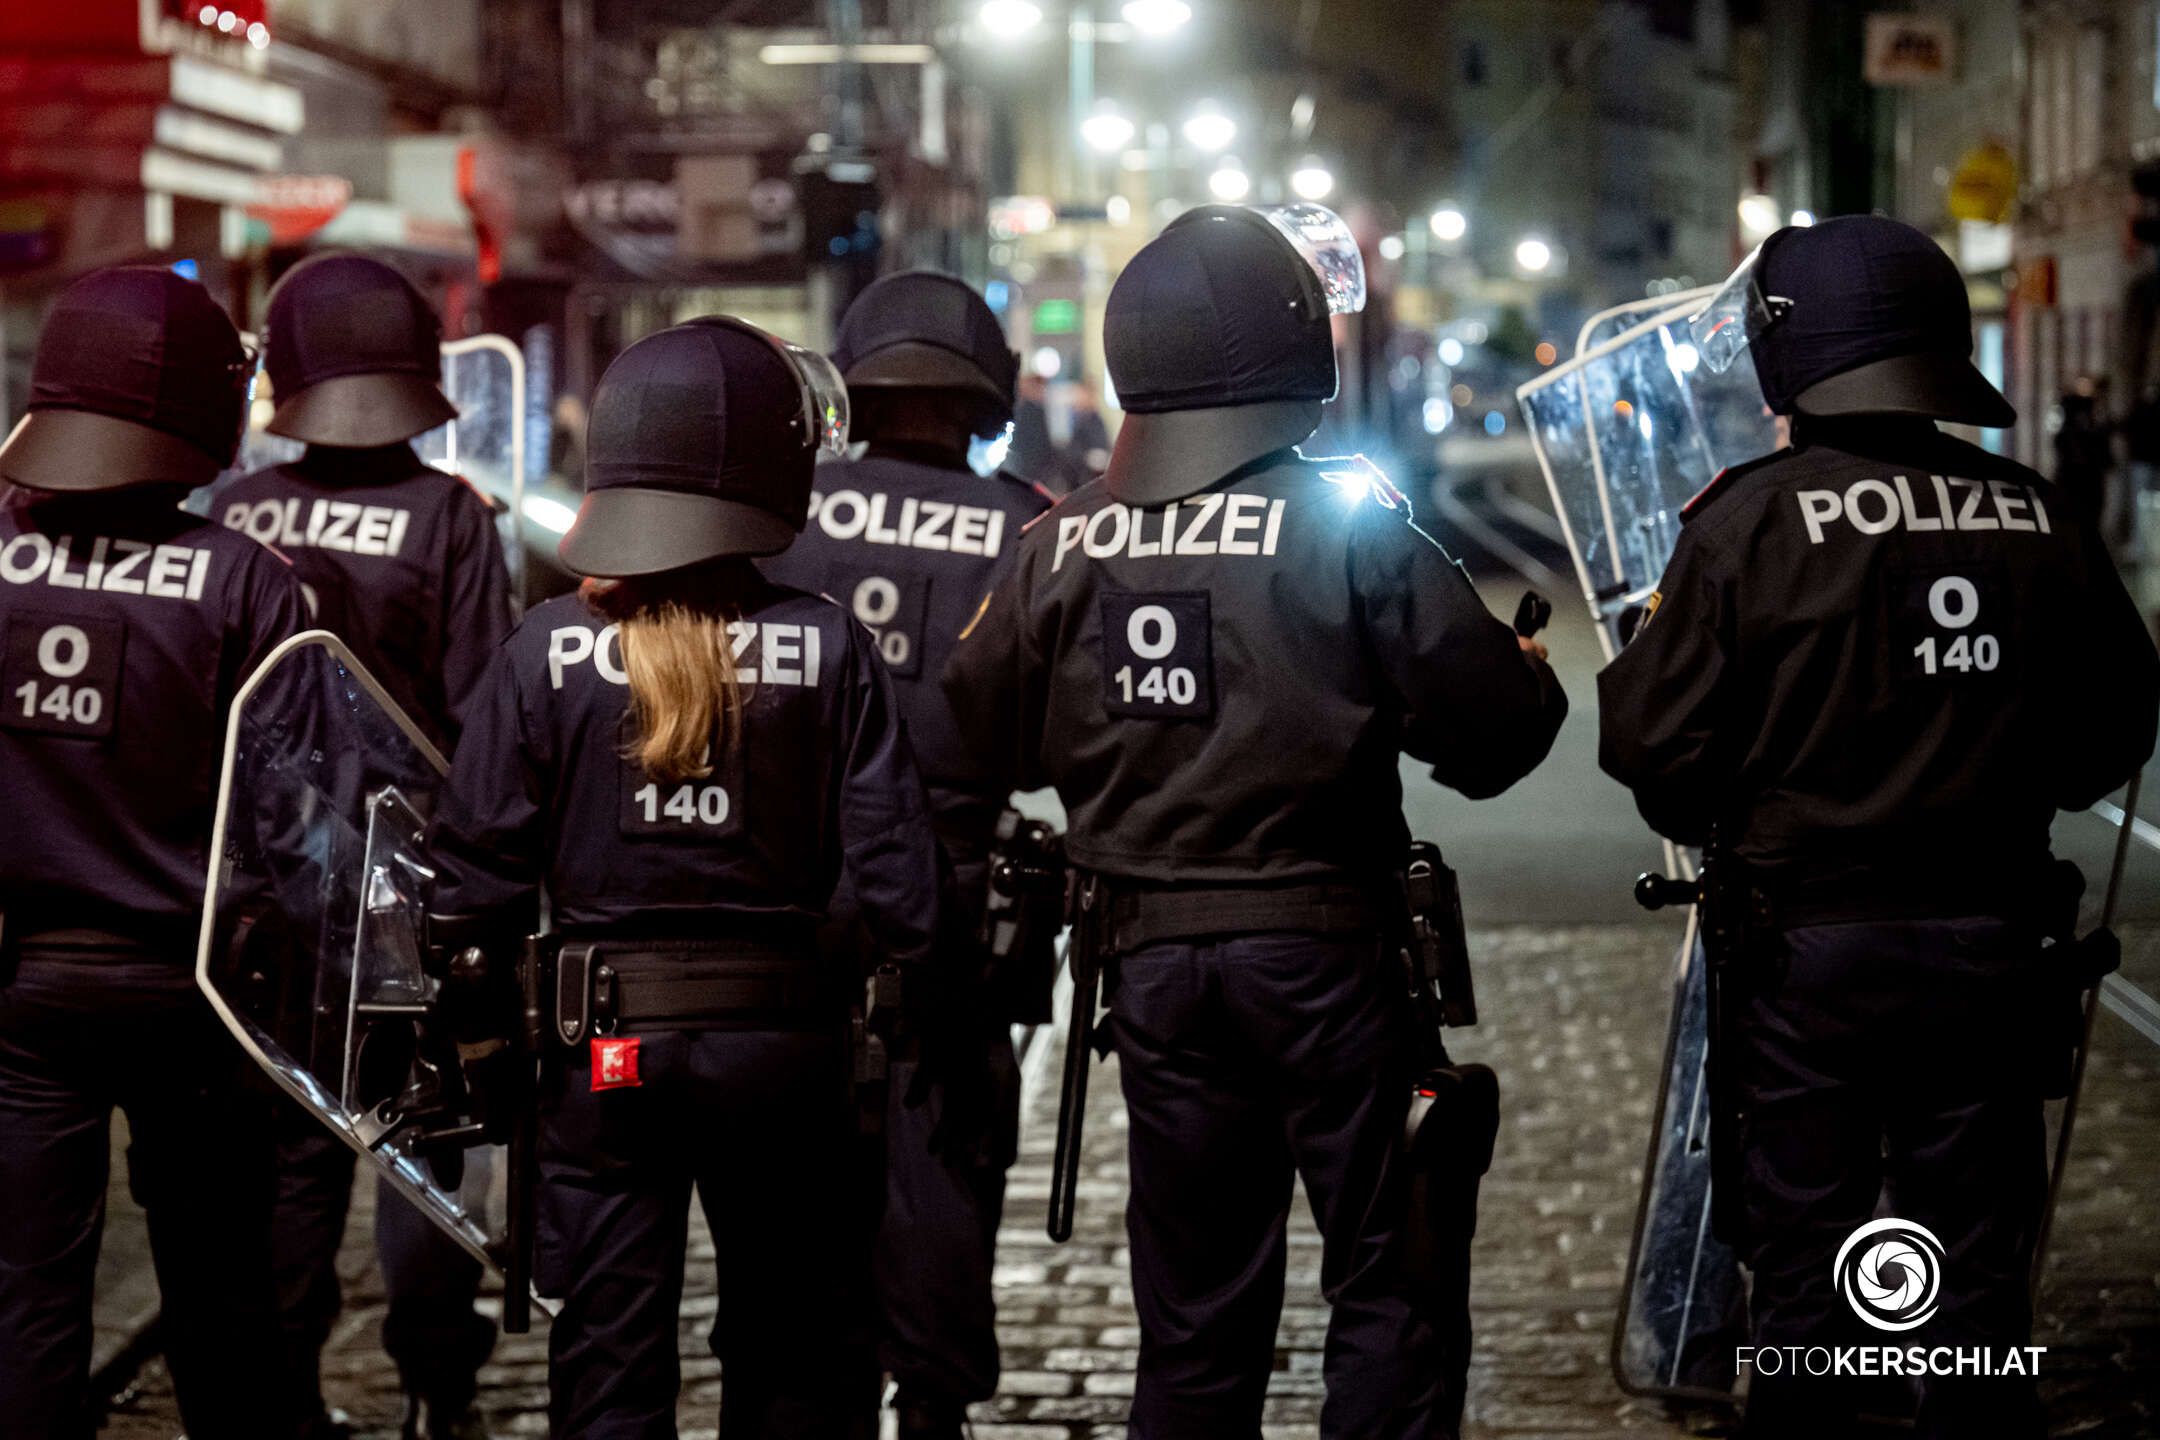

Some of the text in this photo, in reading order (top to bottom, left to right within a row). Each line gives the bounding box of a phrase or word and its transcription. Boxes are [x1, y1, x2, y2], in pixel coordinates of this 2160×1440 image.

[1051, 493, 1286, 573] POLIZEI
[1797, 475, 2051, 544] POLIZEI
[0, 531, 211, 600] OLIZEI
[548, 622, 821, 690] POZEI
[1914, 634, 2000, 674] 140
[15, 680, 102, 725] 140
[1115, 665, 1197, 704] 140
[635, 783, 730, 825] 140
